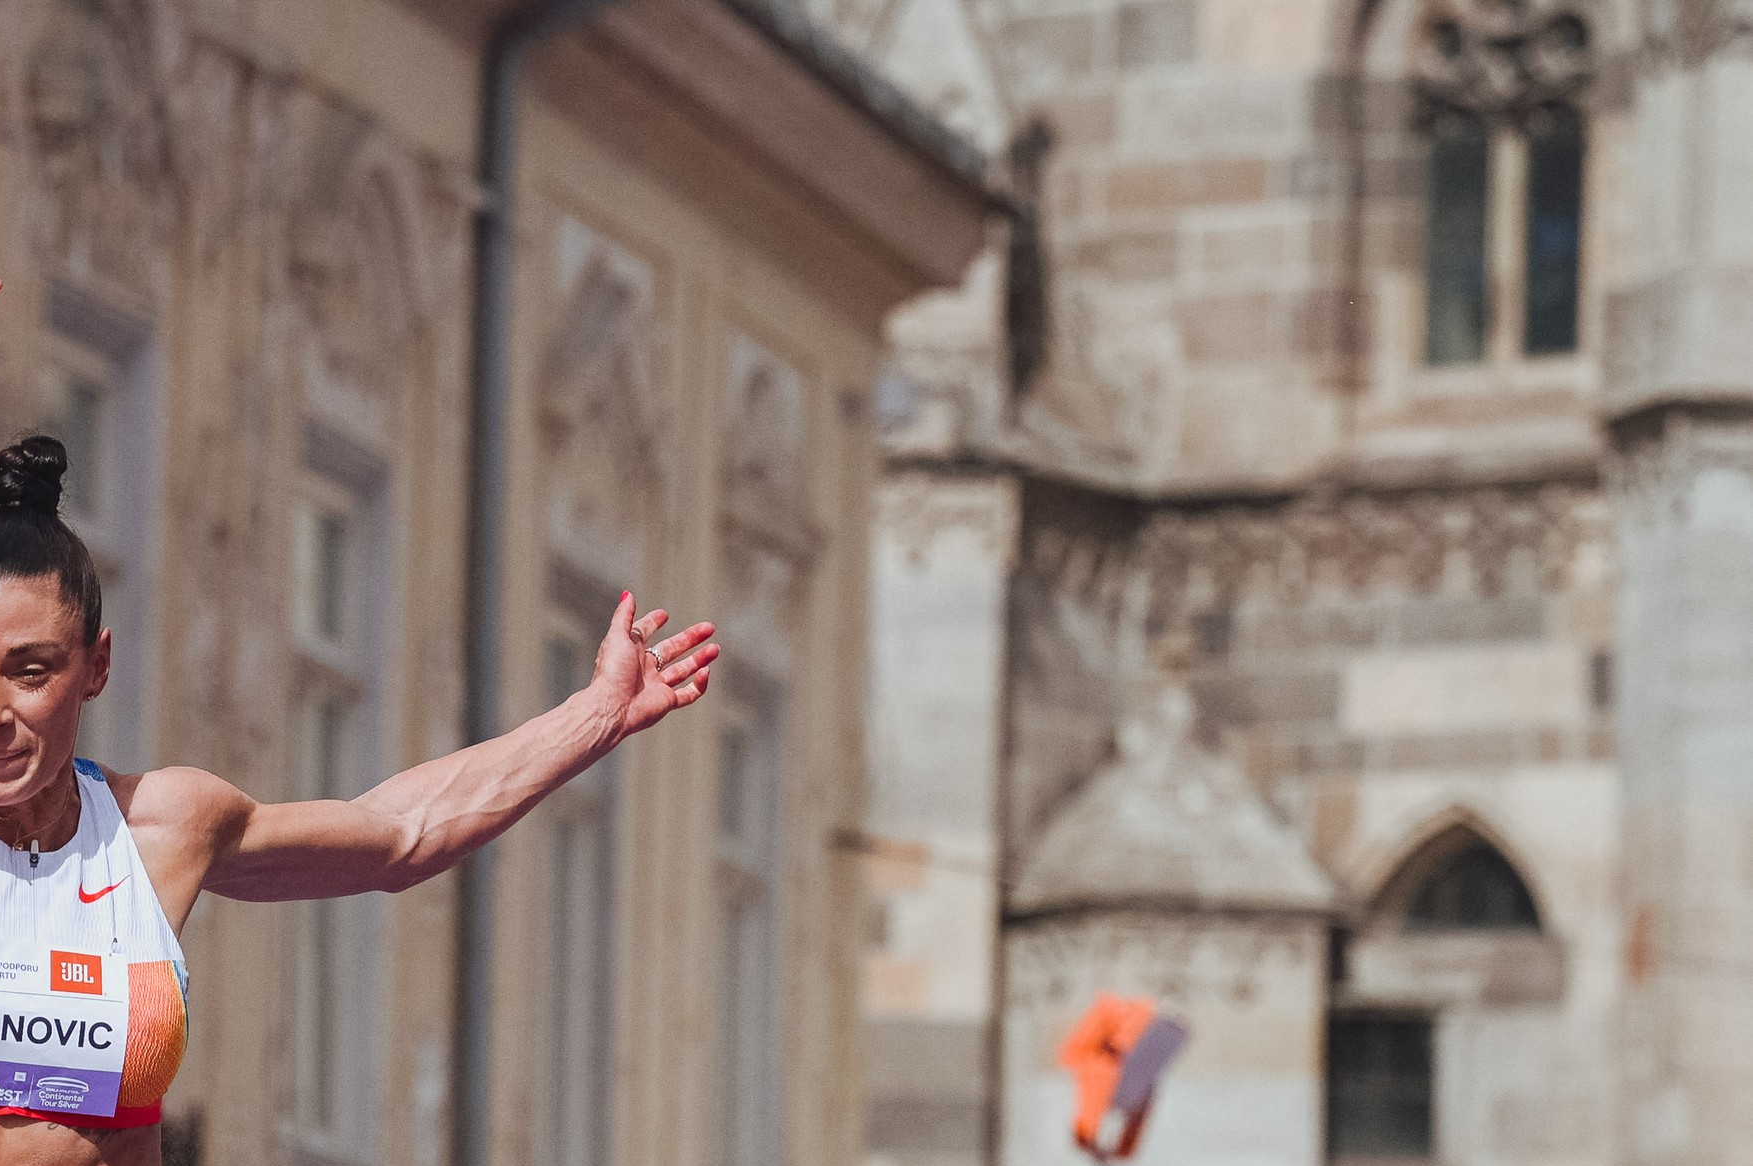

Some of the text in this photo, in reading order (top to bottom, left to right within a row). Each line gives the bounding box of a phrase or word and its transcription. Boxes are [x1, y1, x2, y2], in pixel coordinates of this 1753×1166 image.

[60, 962, 94, 984] JBL
[38, 1090, 84, 1102] Continental
[40, 1098, 58, 1107] Tour
